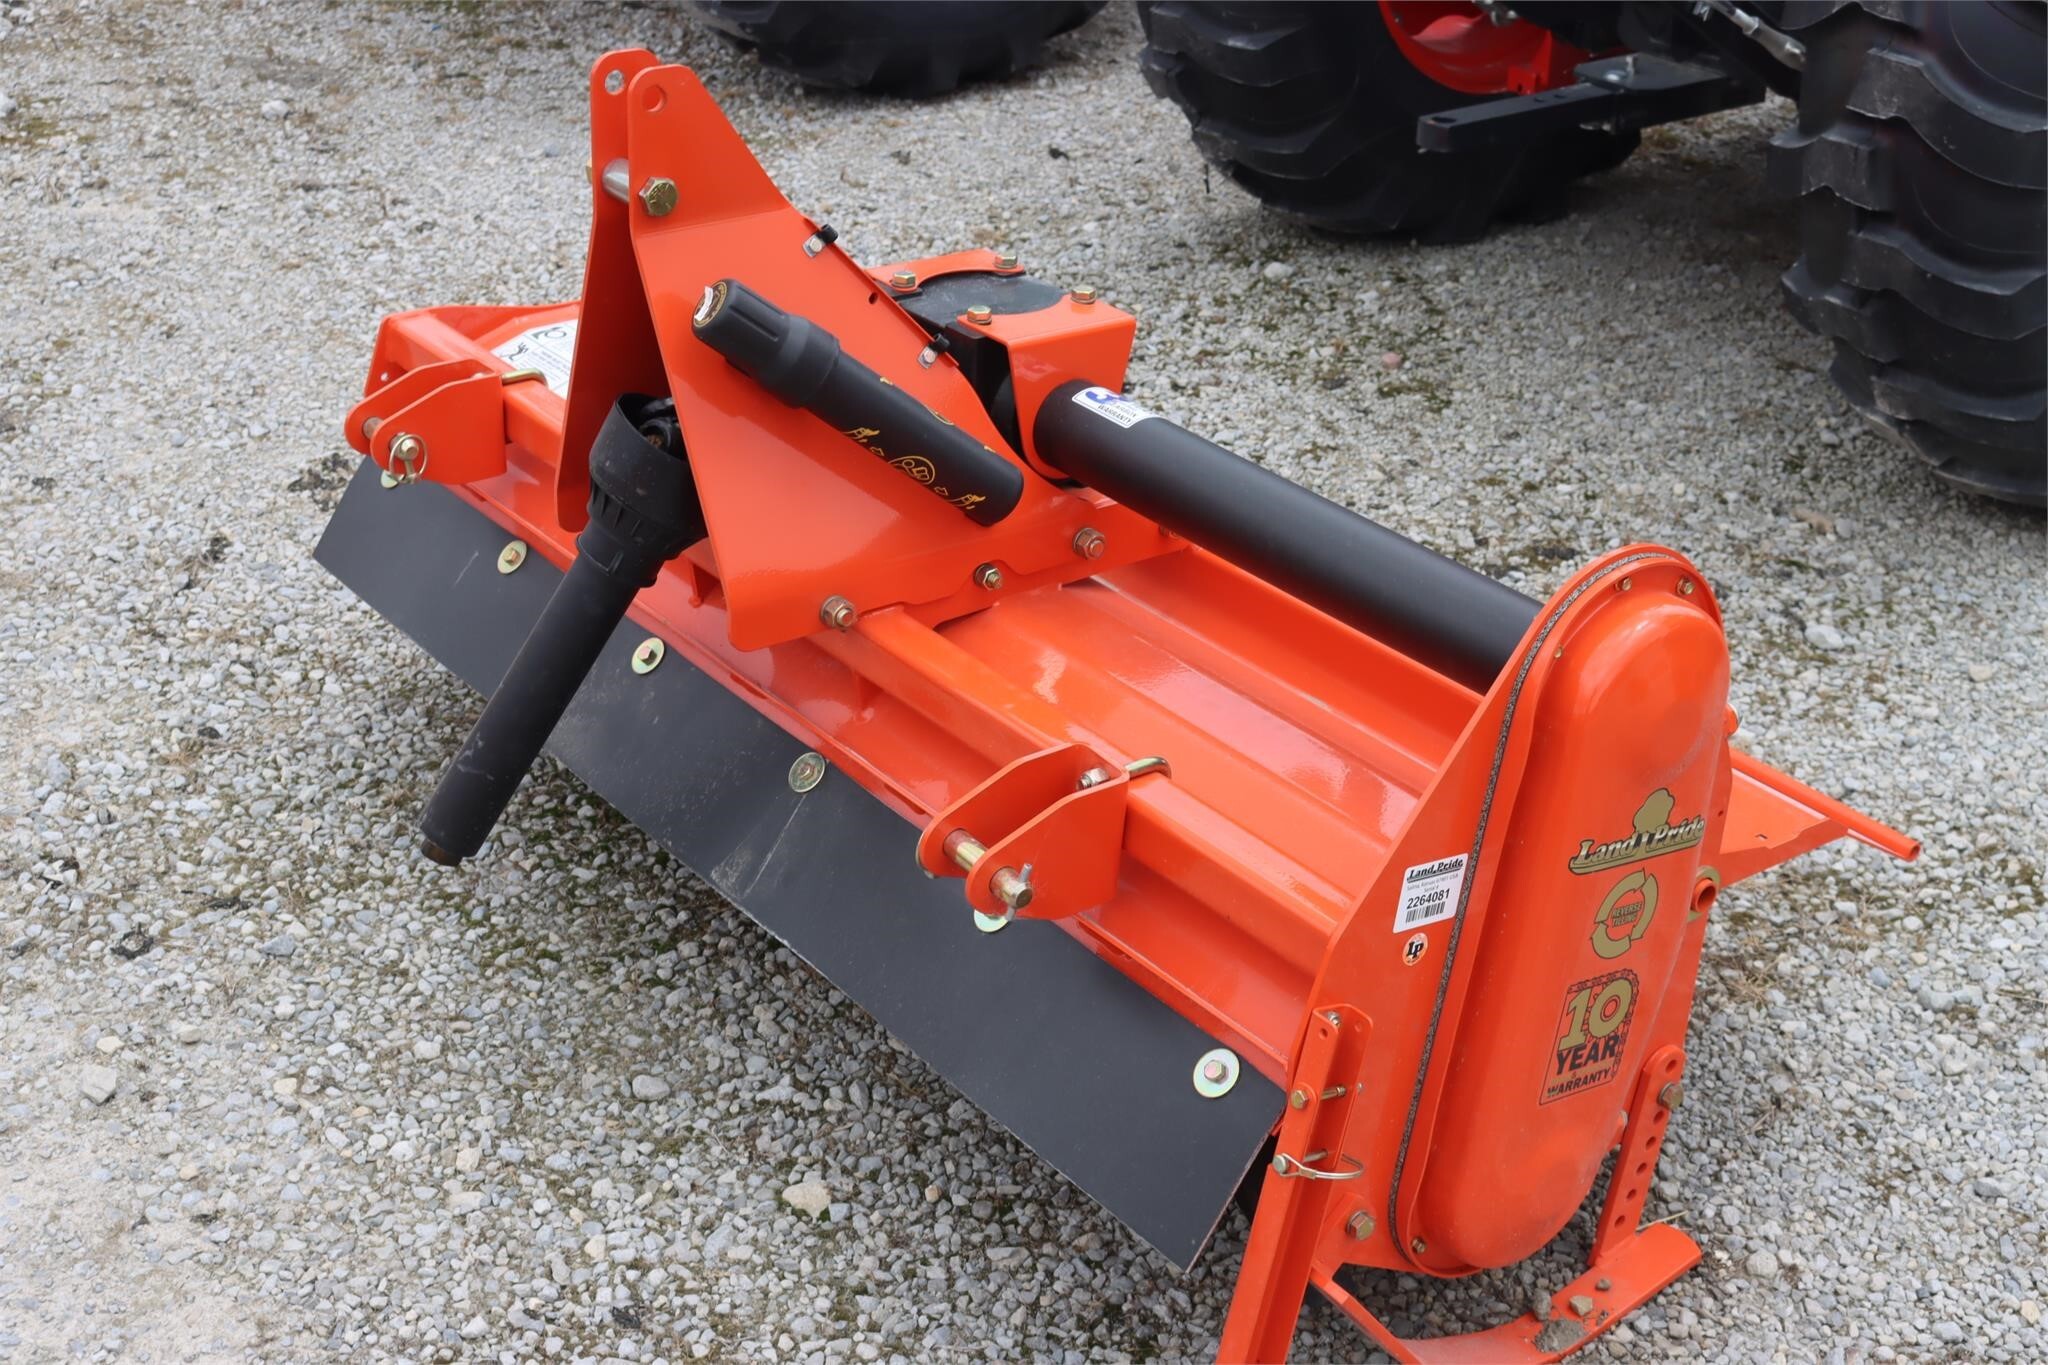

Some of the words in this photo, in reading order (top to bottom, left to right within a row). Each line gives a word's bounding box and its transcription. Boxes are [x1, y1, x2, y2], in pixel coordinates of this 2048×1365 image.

[1097, 404, 1131, 423] WARRANTY
[1573, 832, 1638, 866] Land
[1650, 814, 1705, 850] Pride
[1408, 864, 1435, 879] Land
[1436, 858, 1464, 873] Pride
[1406, 888, 1450, 910] 2264081
[1611, 902, 1642, 918] REVERSE
[1406, 941, 1424, 959] LP
[1558, 977, 1634, 1051] 10
[1556, 1034, 1620, 1075] YEAR
[1547, 1067, 1611, 1098] WARRANTY
